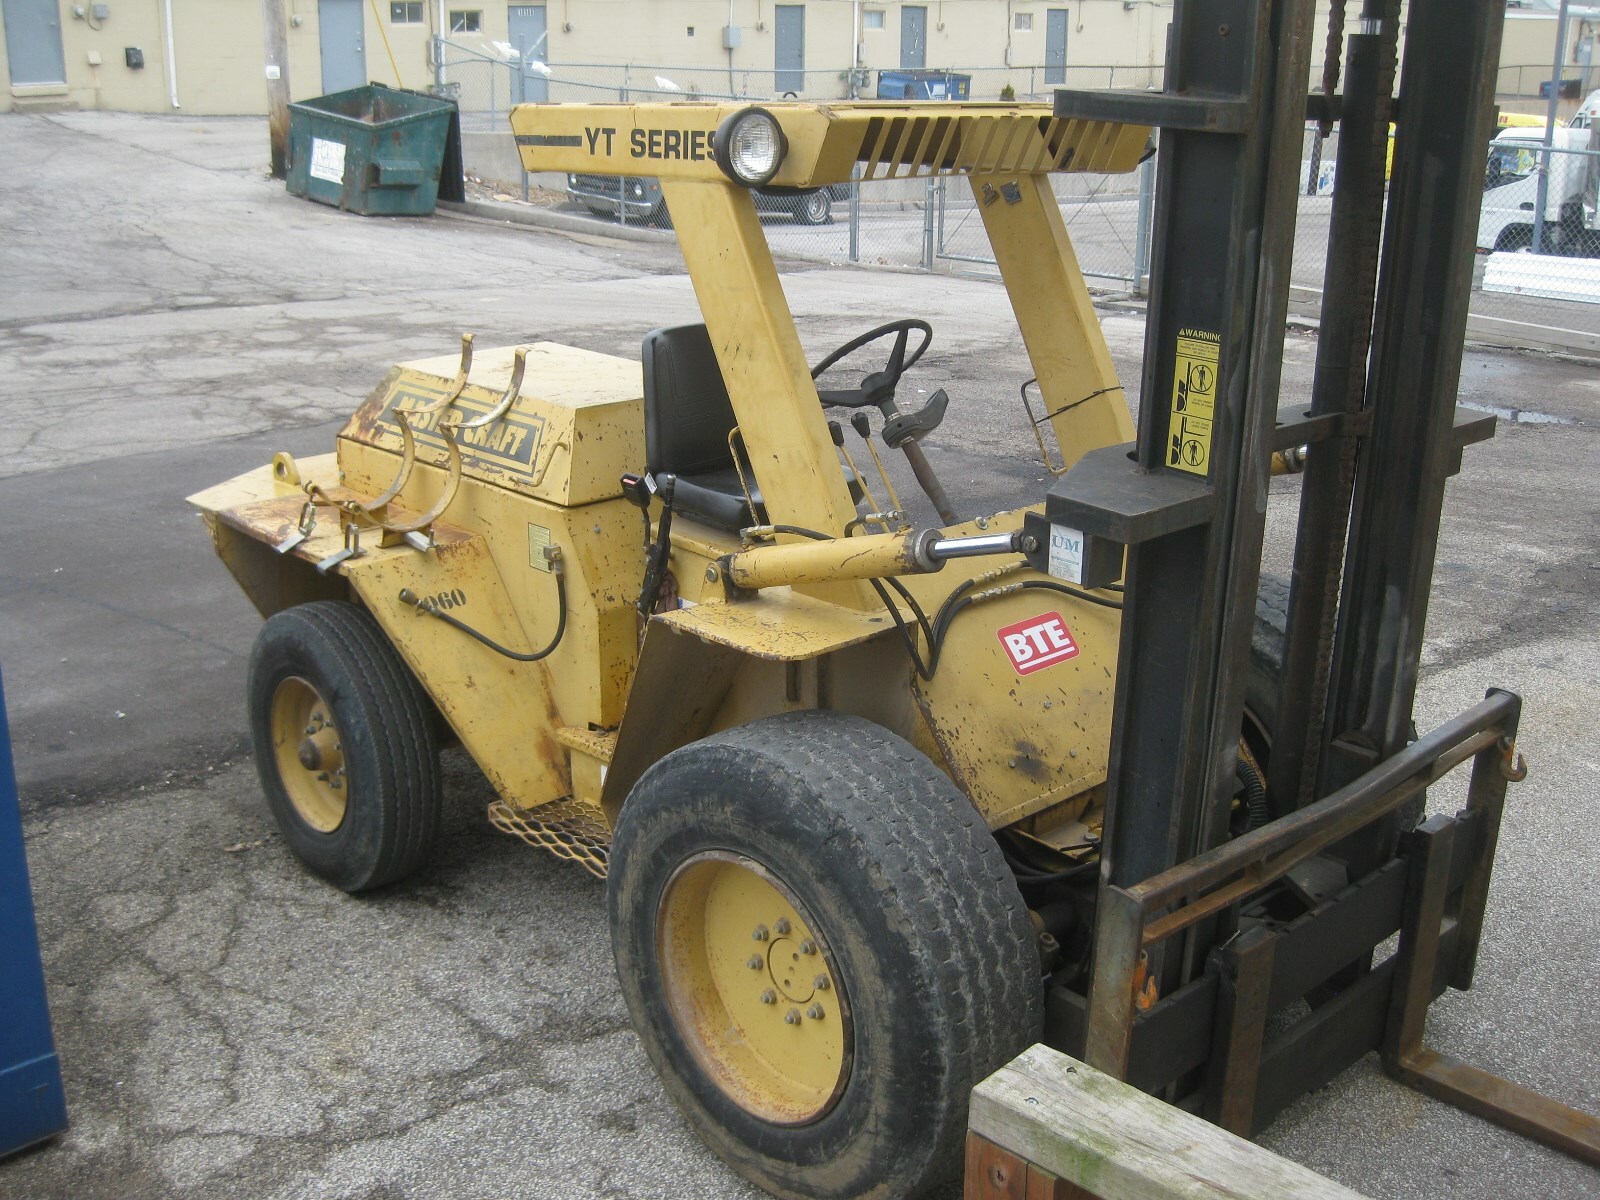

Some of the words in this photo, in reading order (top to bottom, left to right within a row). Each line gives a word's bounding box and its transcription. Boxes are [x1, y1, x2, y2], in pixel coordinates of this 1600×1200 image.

[585, 127, 616, 156] YT
[463, 415, 528, 456] CRAFT
[1003, 618, 1071, 663] BTE
